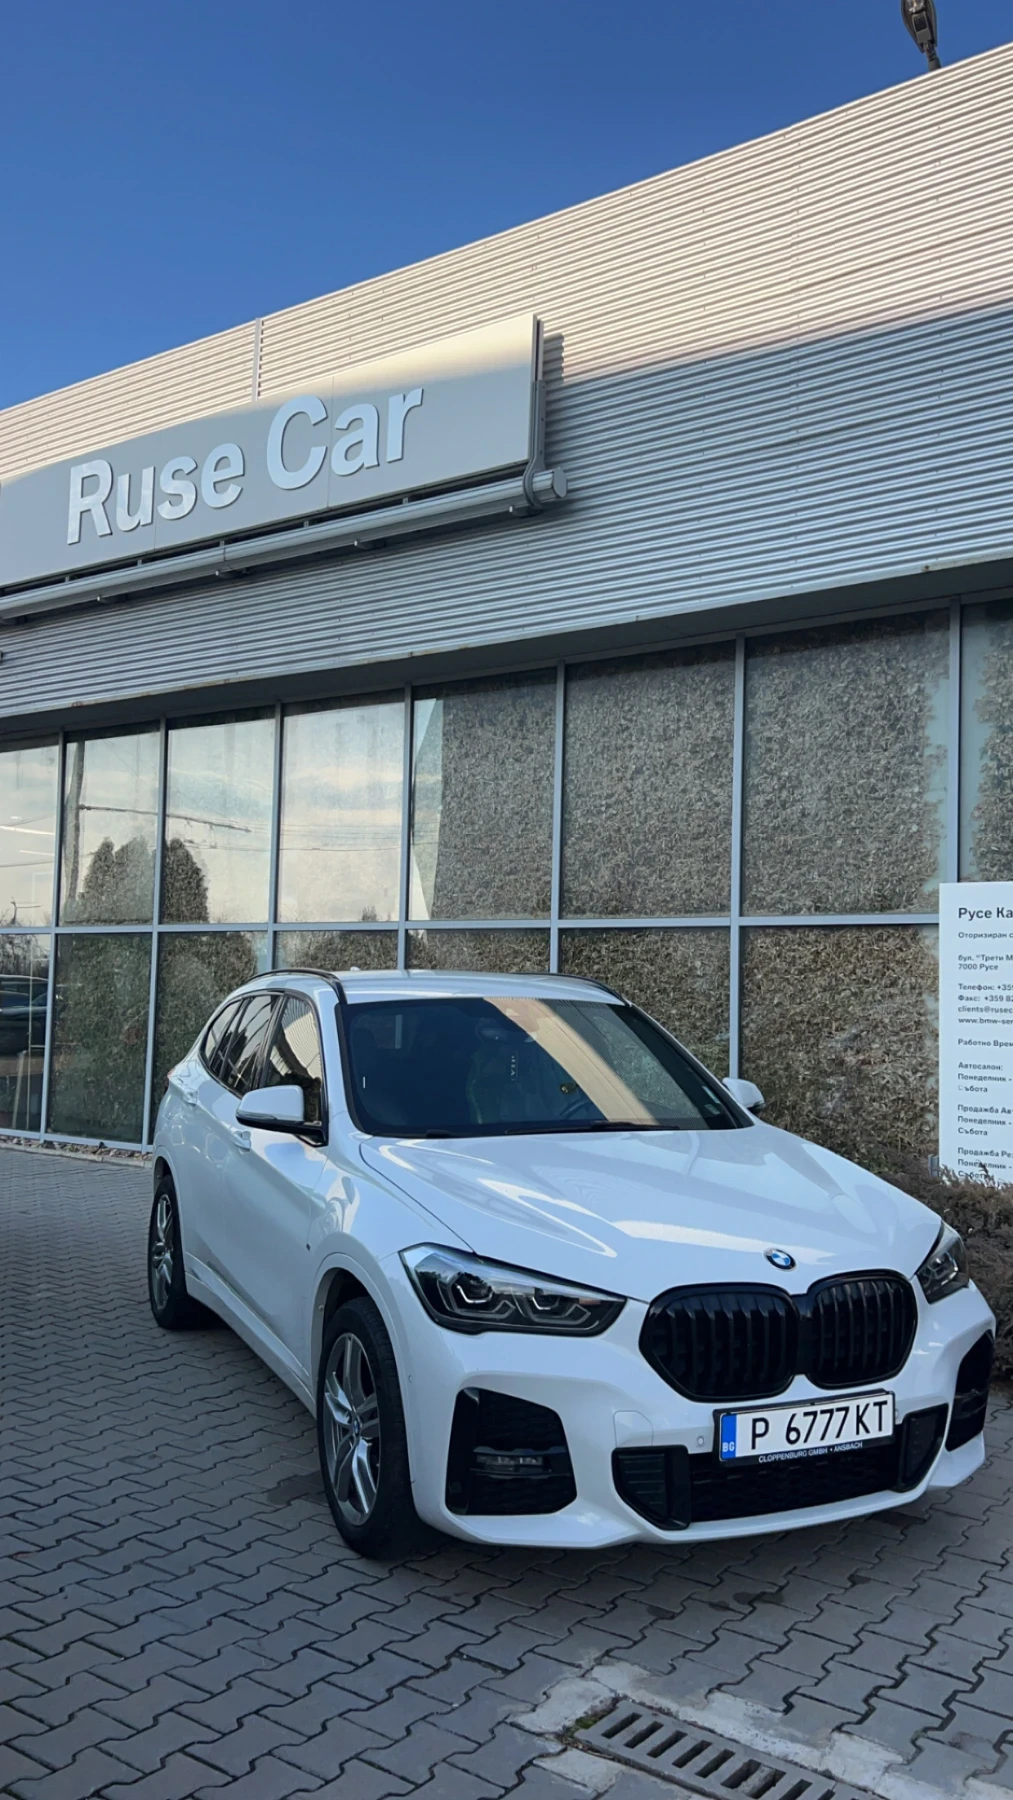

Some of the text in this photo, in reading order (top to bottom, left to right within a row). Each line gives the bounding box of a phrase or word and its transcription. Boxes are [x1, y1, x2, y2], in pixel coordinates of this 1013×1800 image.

[66, 387, 424, 545] Ruse Car
[958, 907, 1013, 921] Русе Ка
[958, 932, 1007, 940] Оторизиран
[958, 954, 974, 962] бул.
[979, 963, 999, 971] Русе
[958, 983, 995, 991] Телефон:
[958, 1038, 991, 1046] Работно
[958, 1062, 1003, 1071] Автосалон:
[958, 1073, 1006, 1082] Понеделник
[958, 1085, 988, 1093] Събота
[958, 1104, 999, 1114] Продажба
[958, 1115, 1006, 1125] Понеделник
[958, 1127, 988, 1136] Събота
[958, 1147, 999, 1157] Продажба
[751, 1416, 769, 1450] P
[722, 1441, 735, 1452] BG
[758, 1441, 863, 1463] CLOPPENBURG GMBH ANSBACH
